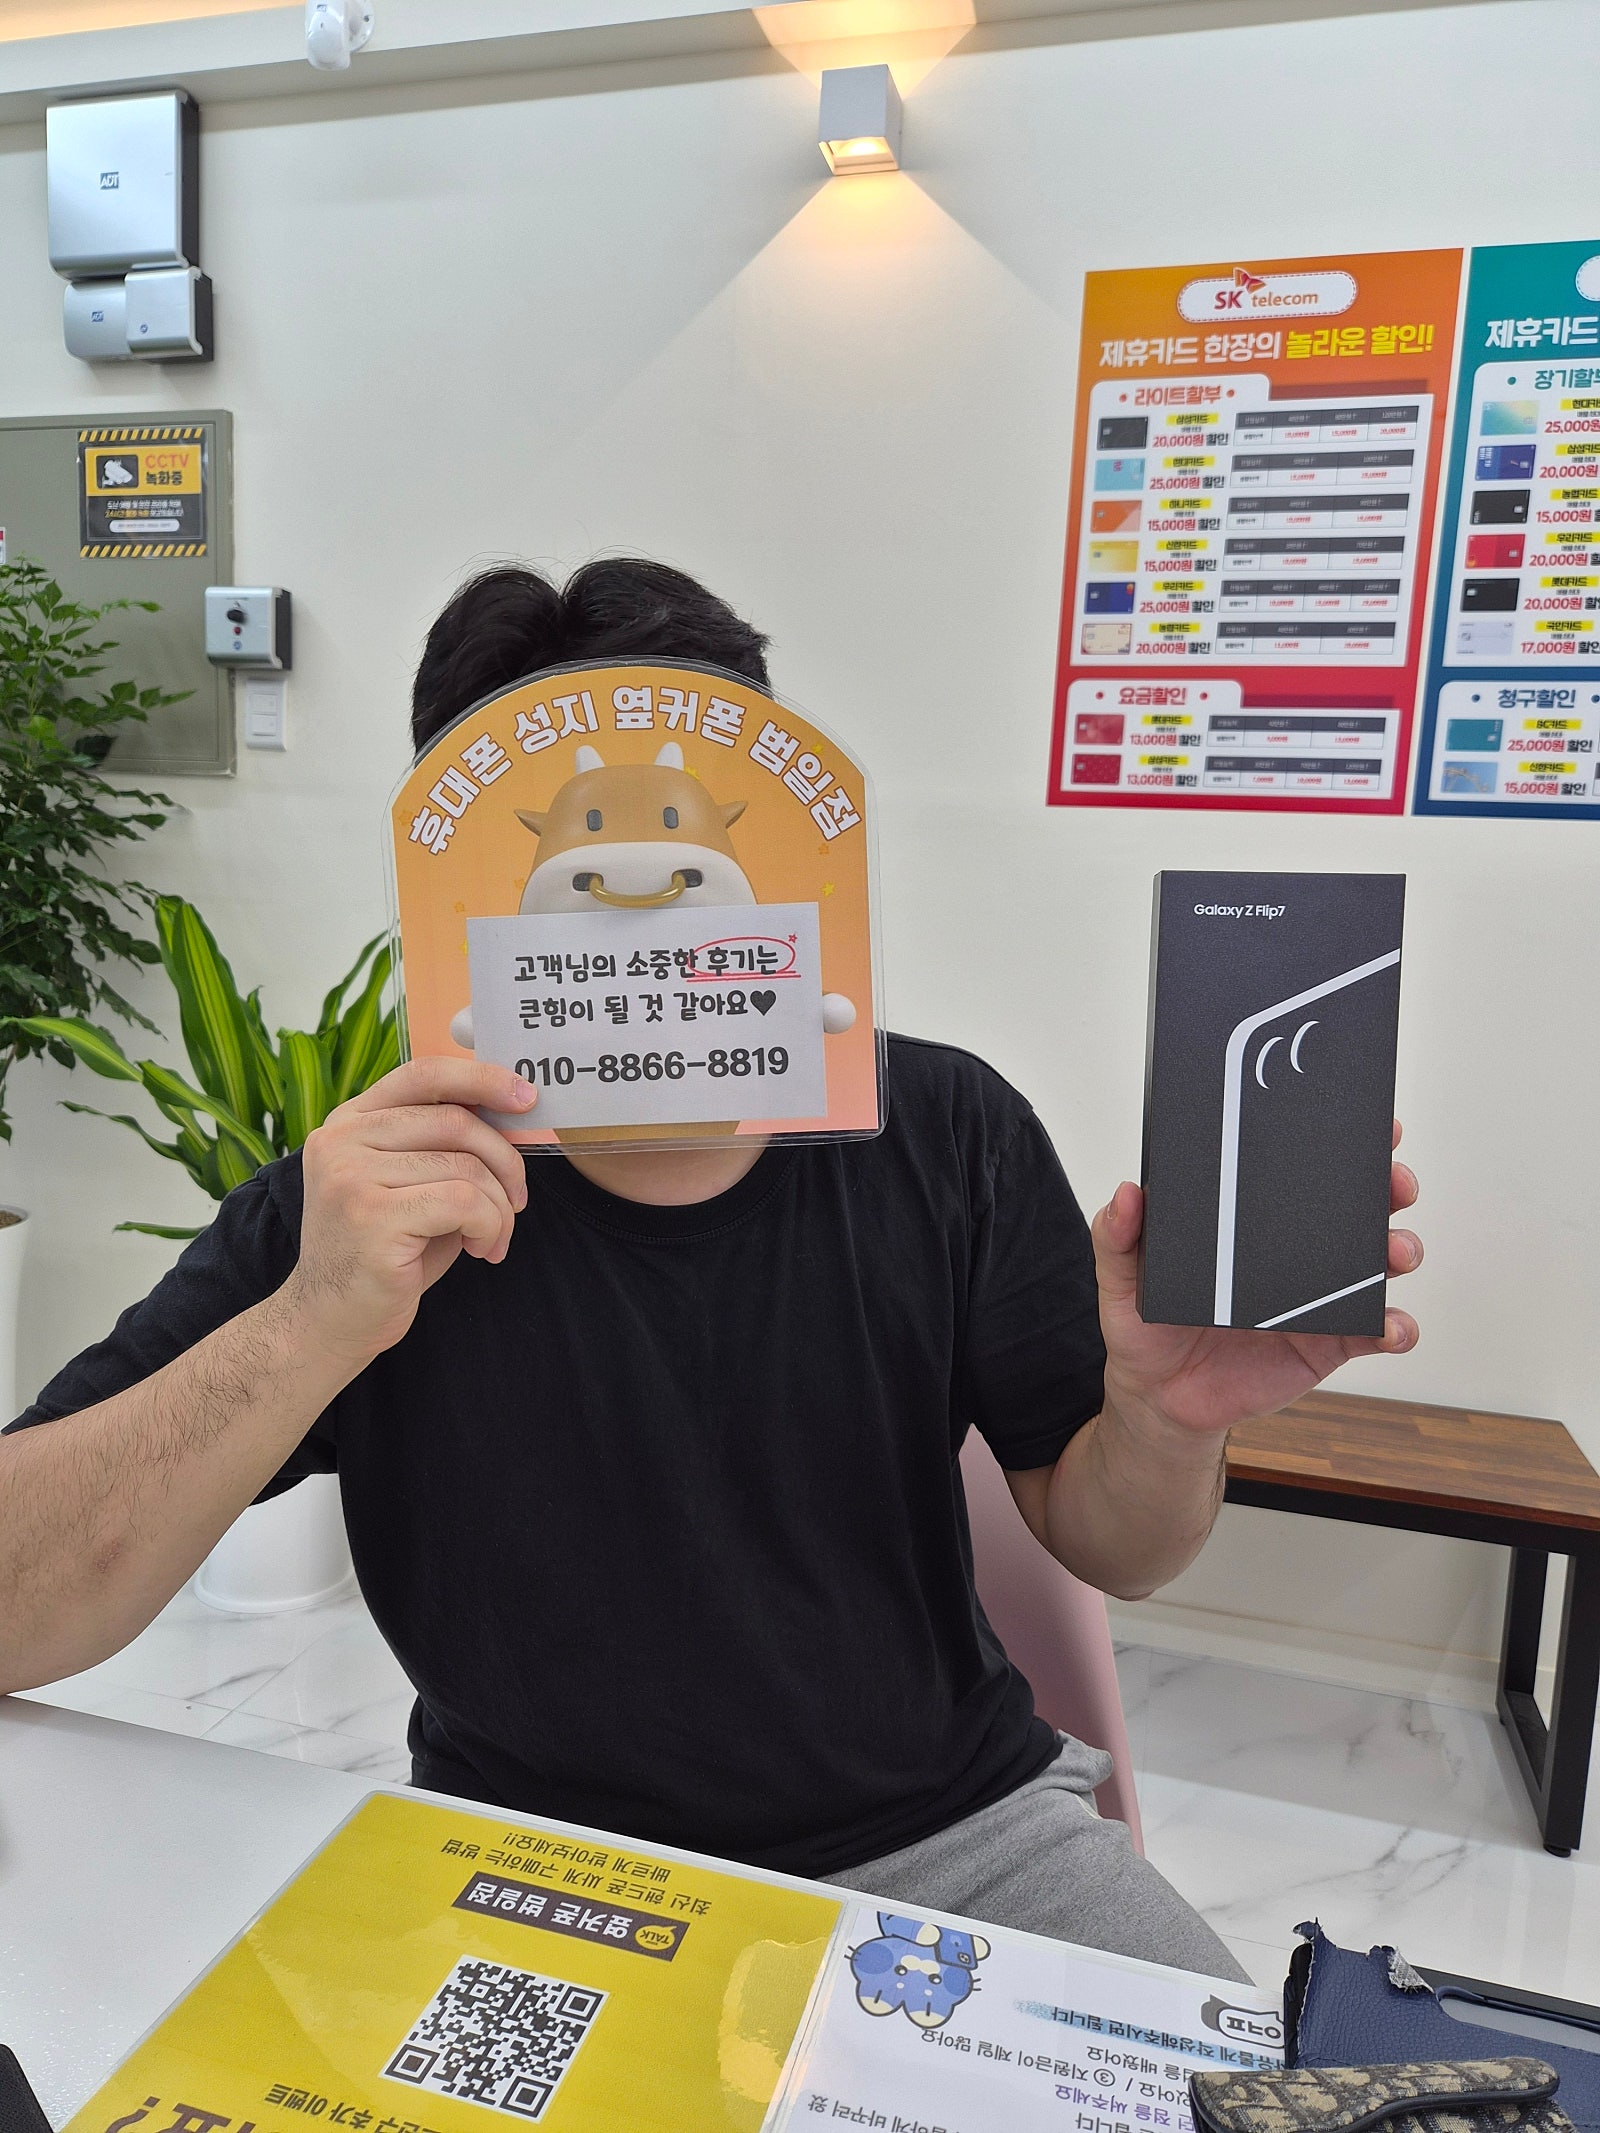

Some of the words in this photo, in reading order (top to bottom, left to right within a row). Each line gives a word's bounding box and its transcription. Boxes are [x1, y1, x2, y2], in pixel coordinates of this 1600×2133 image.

[100, 173, 120, 189] ADT
[1214, 290, 1243, 310] SK
[1251, 291, 1318, 308] telecom
[1484, 316, 1599, 348] 제휴카드
[1099, 337, 1199, 368] 제휴카드
[1203, 331, 1281, 364] 한장의
[1286, 325, 1366, 360] 놀라운
[1370, 324, 1434, 355] 할인!
[1134, 385, 1221, 407] 라이트할부
[1572, 399, 1600, 409] 현대카
[1152, 435, 1204, 448] 20,000원
[1206, 433, 1229, 446] 할인
[144, 454, 190, 469] CCTV
[1539, 465, 1598, 479] 20,000원
[1150, 477, 1200, 490] 25,000원
[1202, 476, 1225, 489] 할인
[1147, 519, 1195, 531] 15,000원
[1197, 519, 1220, 531] 할인
[1536, 510, 1592, 523] 15,000원
[1144, 560, 1192, 572] 15,000원
[1194, 559, 1217, 572] 할인
[1529, 553, 1588, 566] 20,000원
[1140, 602, 1190, 614] 25,000원
[1192, 601, 1214, 613] 할인
[1524, 597, 1583, 610] 20,000원
[1136, 643, 1186, 655] 20,000원
[1188, 642, 1211, 654] 할인
[1520, 641, 1576, 654] 17,000원
[1118, 687, 1187, 706] 요금할인
[1498, 689, 1576, 709] 청구할인
[1536, 719, 1568, 730] BC카드
[1130, 735, 1177, 746] 13,000원
[1179, 735, 1201, 746] 할인
[1507, 739, 1565, 752] 25,000원
[1567, 739, 1593, 753] 할인
[408, 732, 513, 855] 휴대폰
[514, 691, 600, 755] 성지
[611, 685, 747, 748] 옆커폰
[747, 719, 862, 841] 범일점
[1127, 775, 1173, 786] 13,000원
[1175, 775, 1197, 787] 할인
[1504, 782, 1559, 796] 15,000원
[1561, 783, 1586, 796] 할인
[1194, 904, 1244, 919] Galaxy
[1245, 905, 1254, 916] Z
[1255, 904, 1286, 920] Flip7
[514, 952, 617, 983] 고객님의
[626, 948, 696, 979] 소중한
[707, 945, 779, 976] 후기는
[518, 997, 593, 1029] 큰힘이
[604, 995, 629, 1025] 될
[638, 993, 664, 1022] 것
[515, 1046, 790, 1086] 010-8866-8819
[440, 1838, 482, 1861] 방법
[502, 1831, 608, 1869] 받아보세요!!
[484, 1850, 560, 1880] 구매하는
[612, 1857, 671, 1884] 빠르게
[562, 1869, 604, 1890] 싸게
[467, 1880, 548, 1918] 범일점
[607, 1879, 665, 1905] 핸드폰
[671, 1893, 712, 1916] 최신
[552, 1901, 634, 1940] 옆커폰
[639, 1929, 670, 1945] TALK
[1051, 2006, 1104, 2032] 됩니다
[920, 2028, 972, 2053] 많아요
[1108, 2020, 1215, 2058] 작성해주시면
[976, 2040, 1012, 2064] 제일
[1086, 2045, 1158, 2075] 배웠어요
[1017, 2048, 1089, 2082] 지원금이
[264, 2083, 328, 2115] 이벤트
[1054, 2084, 1128, 2115] 써주세요
[328, 2102, 373, 2130] 추가
[831, 2100, 887, 2128] 바꾸러
[1134, 2102, 1171, 2127] 점을
